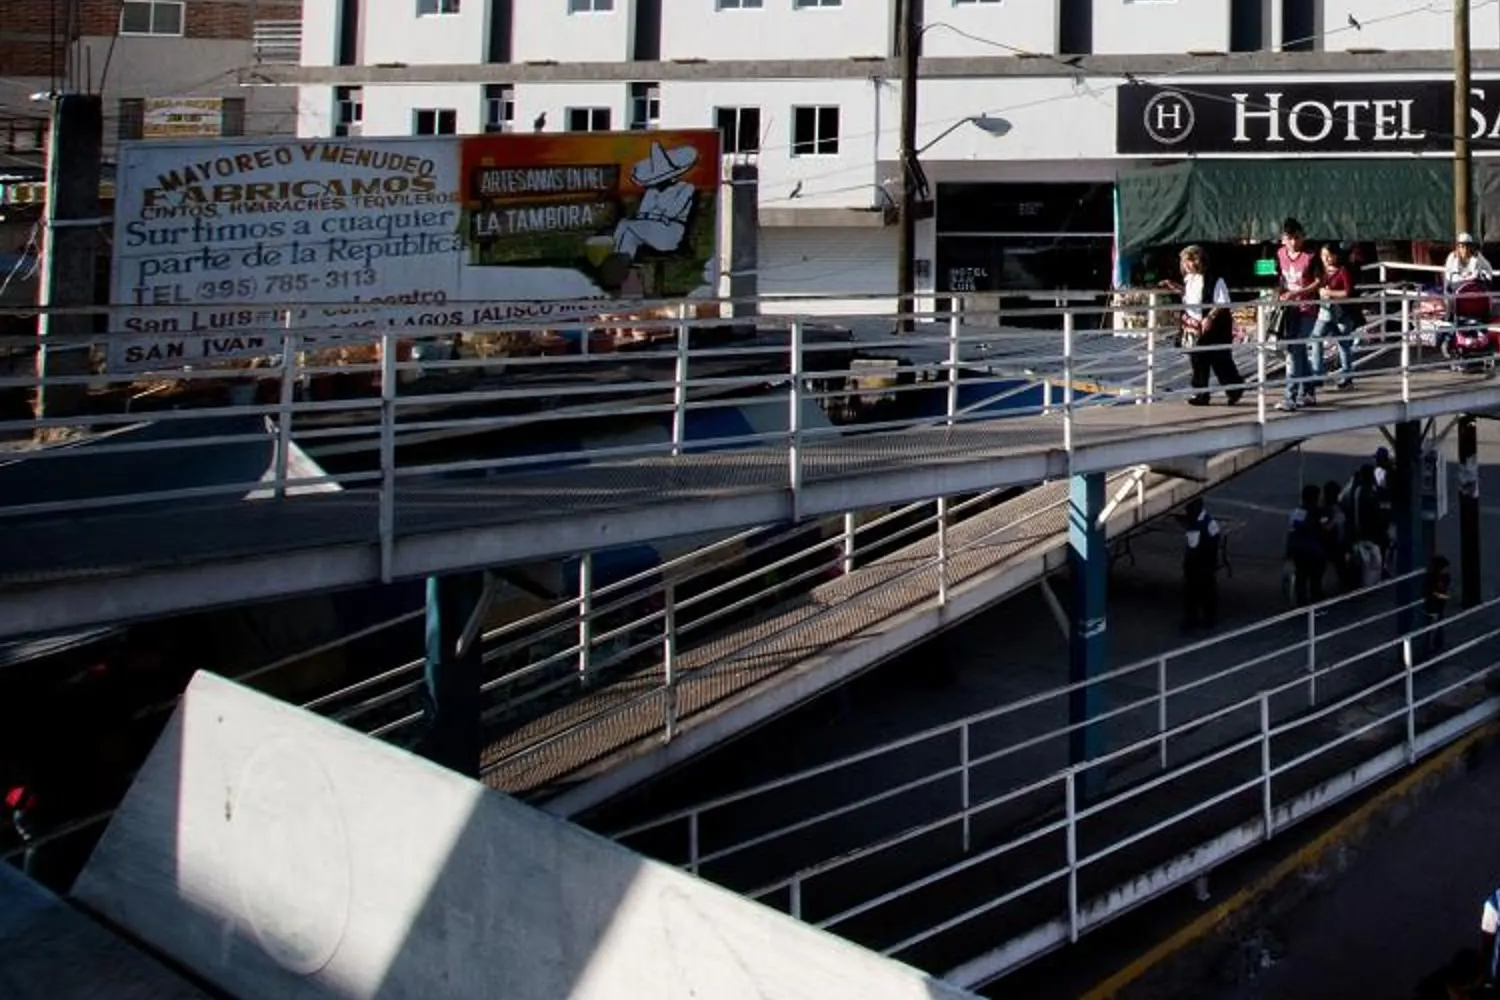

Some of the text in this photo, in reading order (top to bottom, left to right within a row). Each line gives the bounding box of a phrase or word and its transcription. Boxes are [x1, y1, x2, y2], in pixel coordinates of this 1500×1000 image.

[1156, 103, 1181, 129] H
[1231, 93, 1426, 142] HOTEL
[157, 144, 437, 193] MAYOREO Y MENUDEO
[142, 175, 437, 207] FABRICAMOS
[126, 217, 284, 247] Surtimos
[293, 218, 311, 236] a
[476, 211, 500, 236] LA
[139, 246, 231, 286] parte
[241, 242, 282, 268] de
[290, 239, 316, 264] la
[196, 275, 257, 301] (395)
